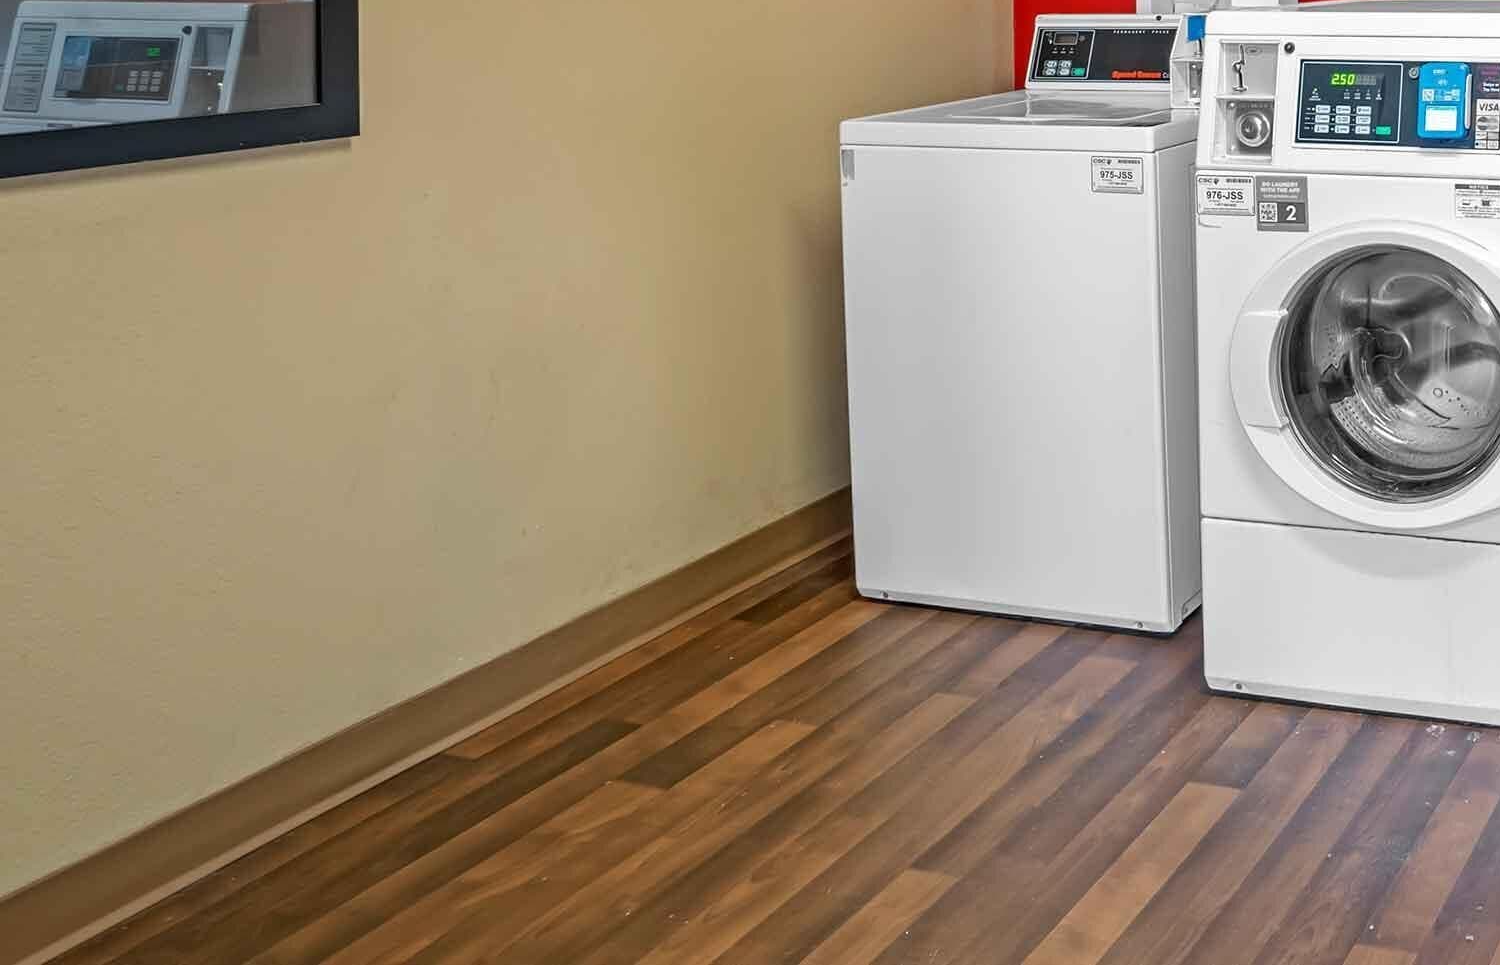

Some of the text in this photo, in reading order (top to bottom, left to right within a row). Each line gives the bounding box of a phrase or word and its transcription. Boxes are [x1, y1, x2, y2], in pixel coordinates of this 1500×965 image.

[1112, 70, 1136, 80] Speed
[1480, 103, 1500, 112] VISA
[1099, 170, 1133, 180] 975-JSS
[1206, 190, 1244, 200] 976-JSS
[1285, 205, 1297, 221] 2
